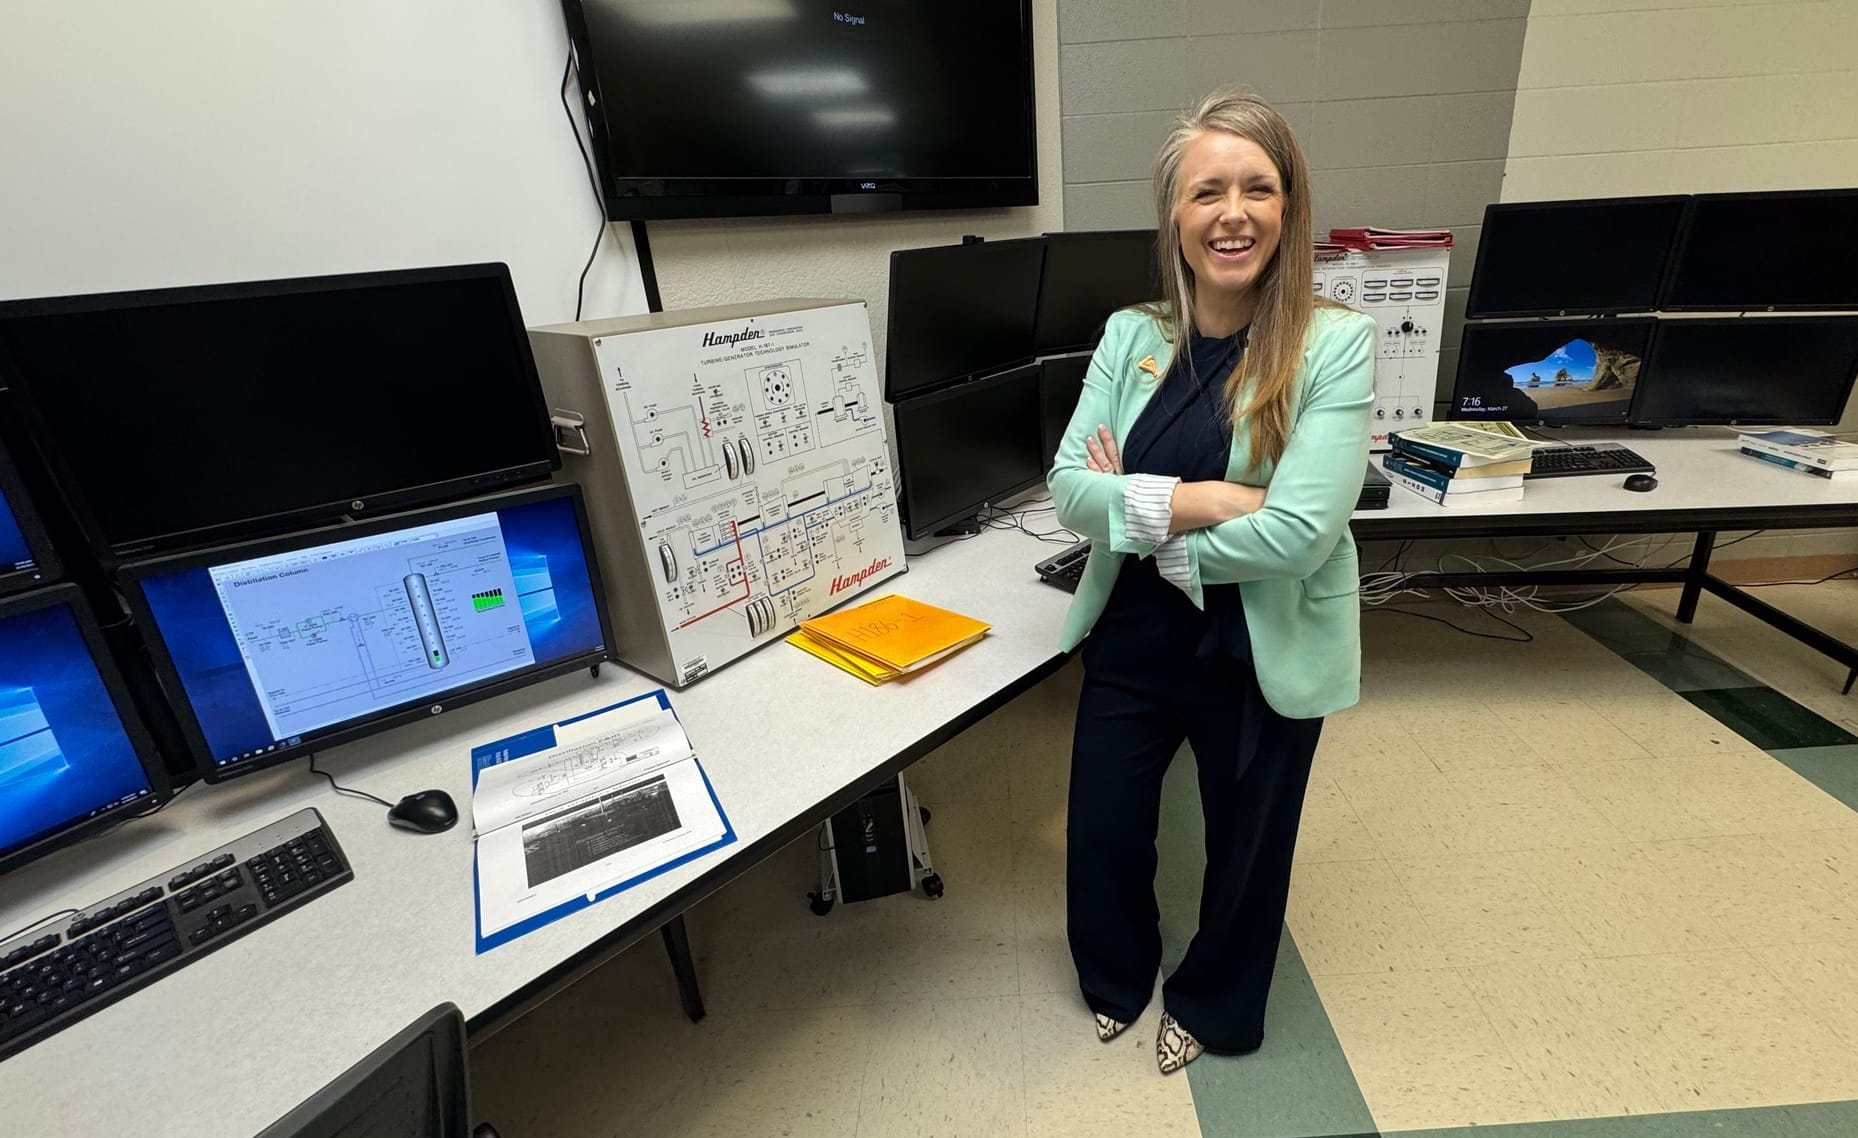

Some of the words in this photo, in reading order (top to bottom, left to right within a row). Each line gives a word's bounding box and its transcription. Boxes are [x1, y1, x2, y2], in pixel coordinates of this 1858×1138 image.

[834, 11, 844, 21] No
[845, 13, 865, 25] Signal
[702, 326, 765, 348] Hampden
[740, 344, 757, 352] MODEL
[755, 344, 785, 356] TECHNOLOGY
[1463, 396, 1481, 406] 7:16
[233, 574, 278, 588] Distillation
[279, 567, 309, 578] Column
[829, 557, 892, 596] Hampden
